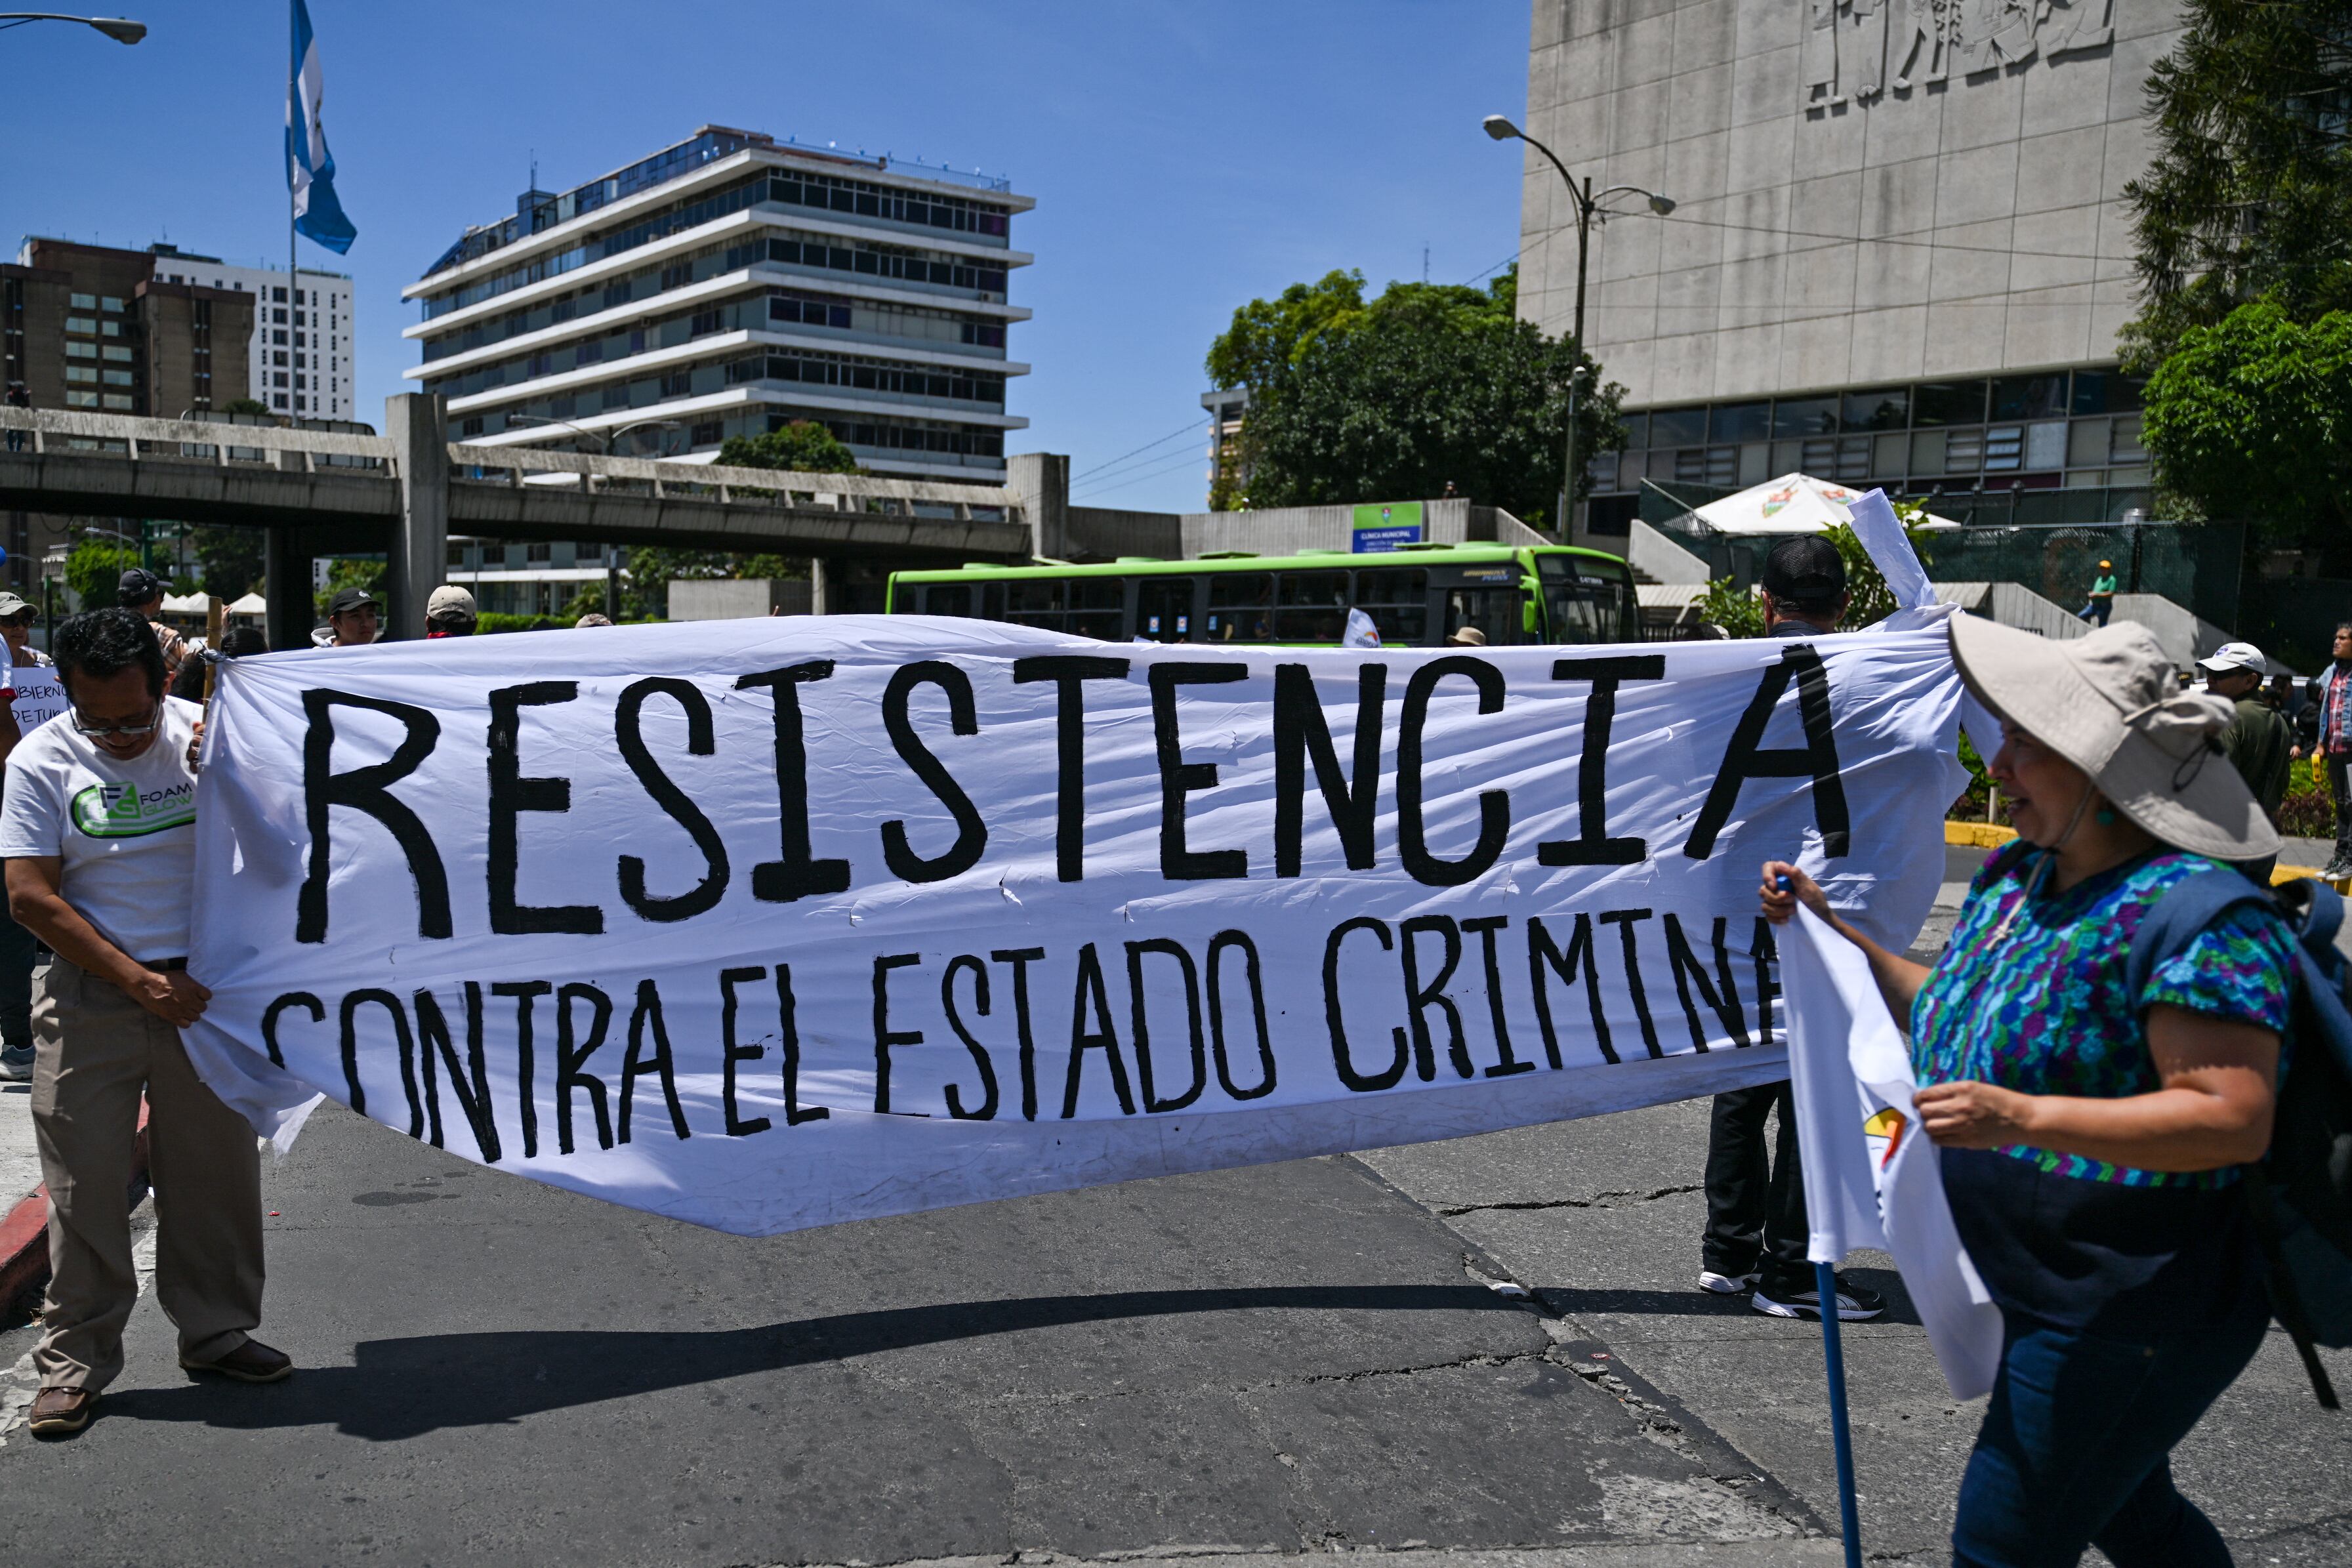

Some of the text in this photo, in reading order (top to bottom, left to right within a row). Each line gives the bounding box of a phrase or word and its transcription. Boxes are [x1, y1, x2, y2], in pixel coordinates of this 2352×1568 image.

[140, 783, 192, 805] FOAM
[142, 794, 193, 816] GLOW
[297, 644, 1851, 943] RESISTENCIA
[261, 907, 1783, 1164] CONTRA EL ESTADO CRIMINA
